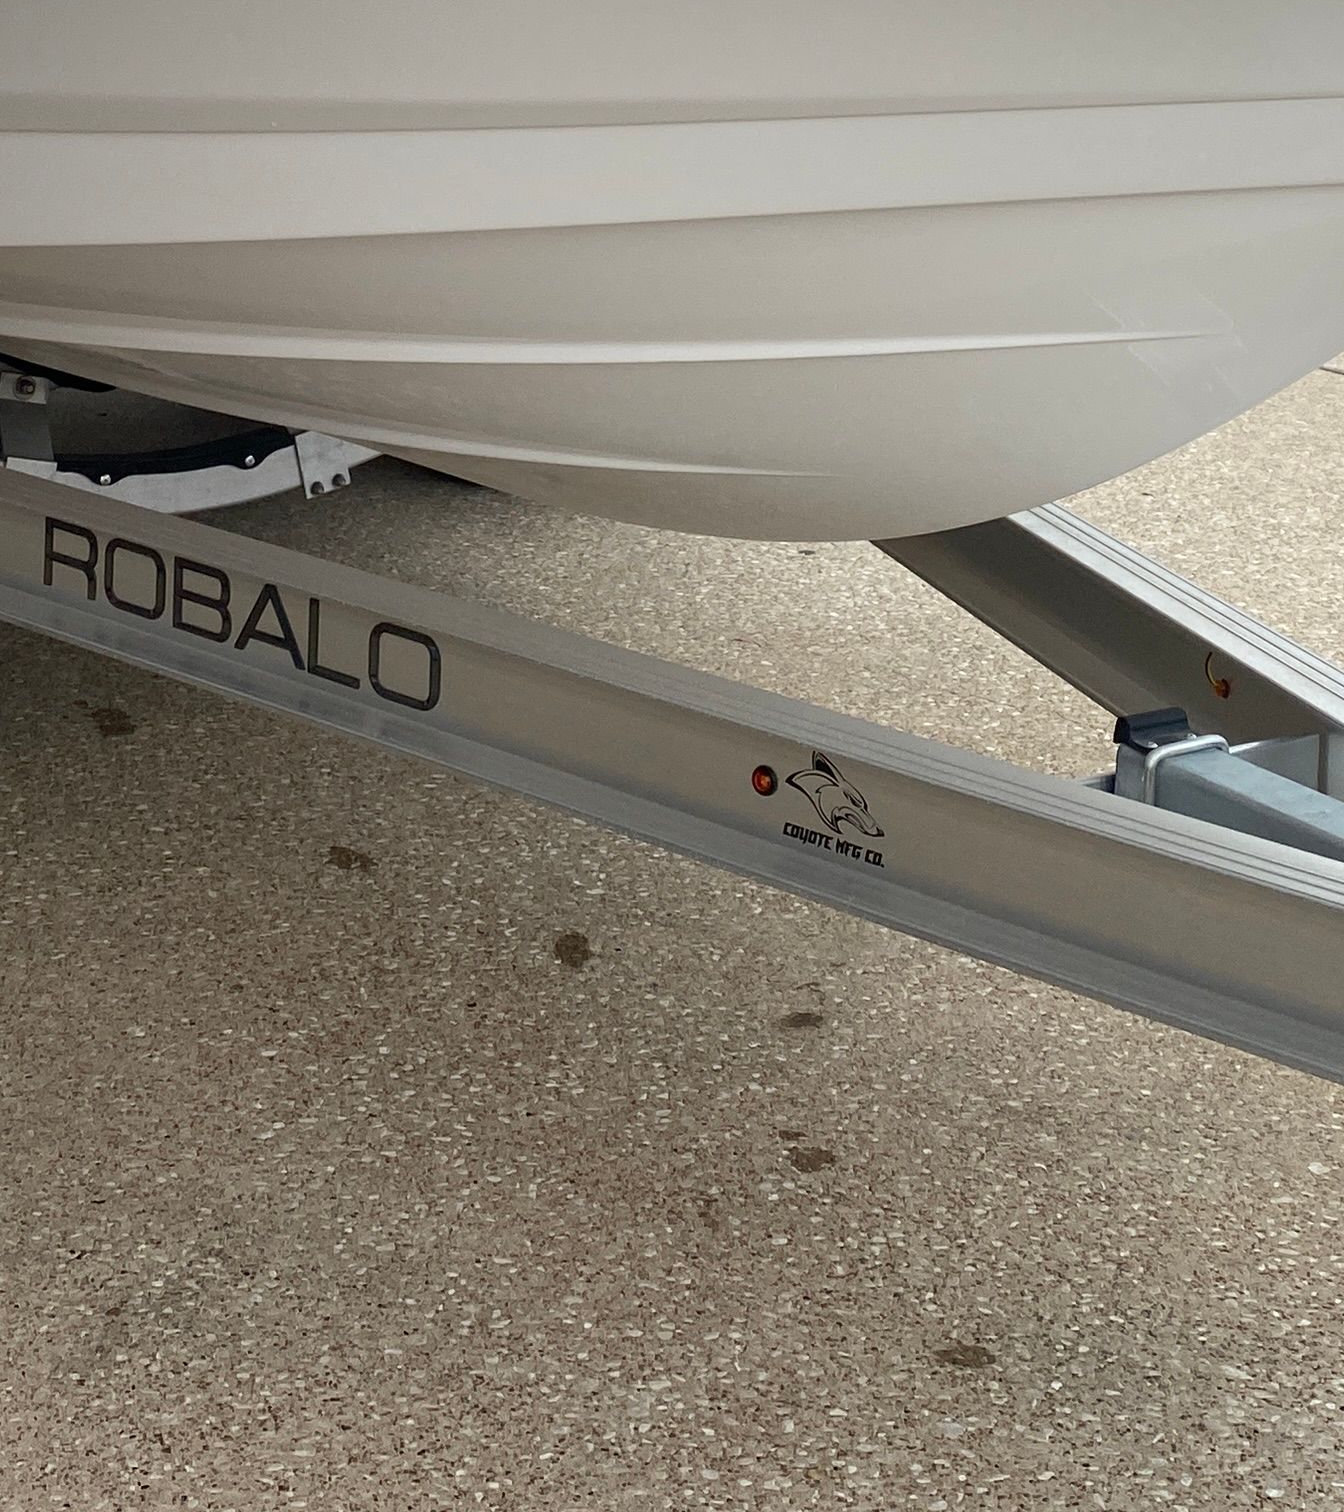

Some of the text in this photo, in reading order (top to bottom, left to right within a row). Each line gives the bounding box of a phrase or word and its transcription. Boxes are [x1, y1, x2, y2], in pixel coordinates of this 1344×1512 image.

[43, 516, 441, 711] ROBALO
[783, 822, 884, 868] COYOTE MFG CO.
